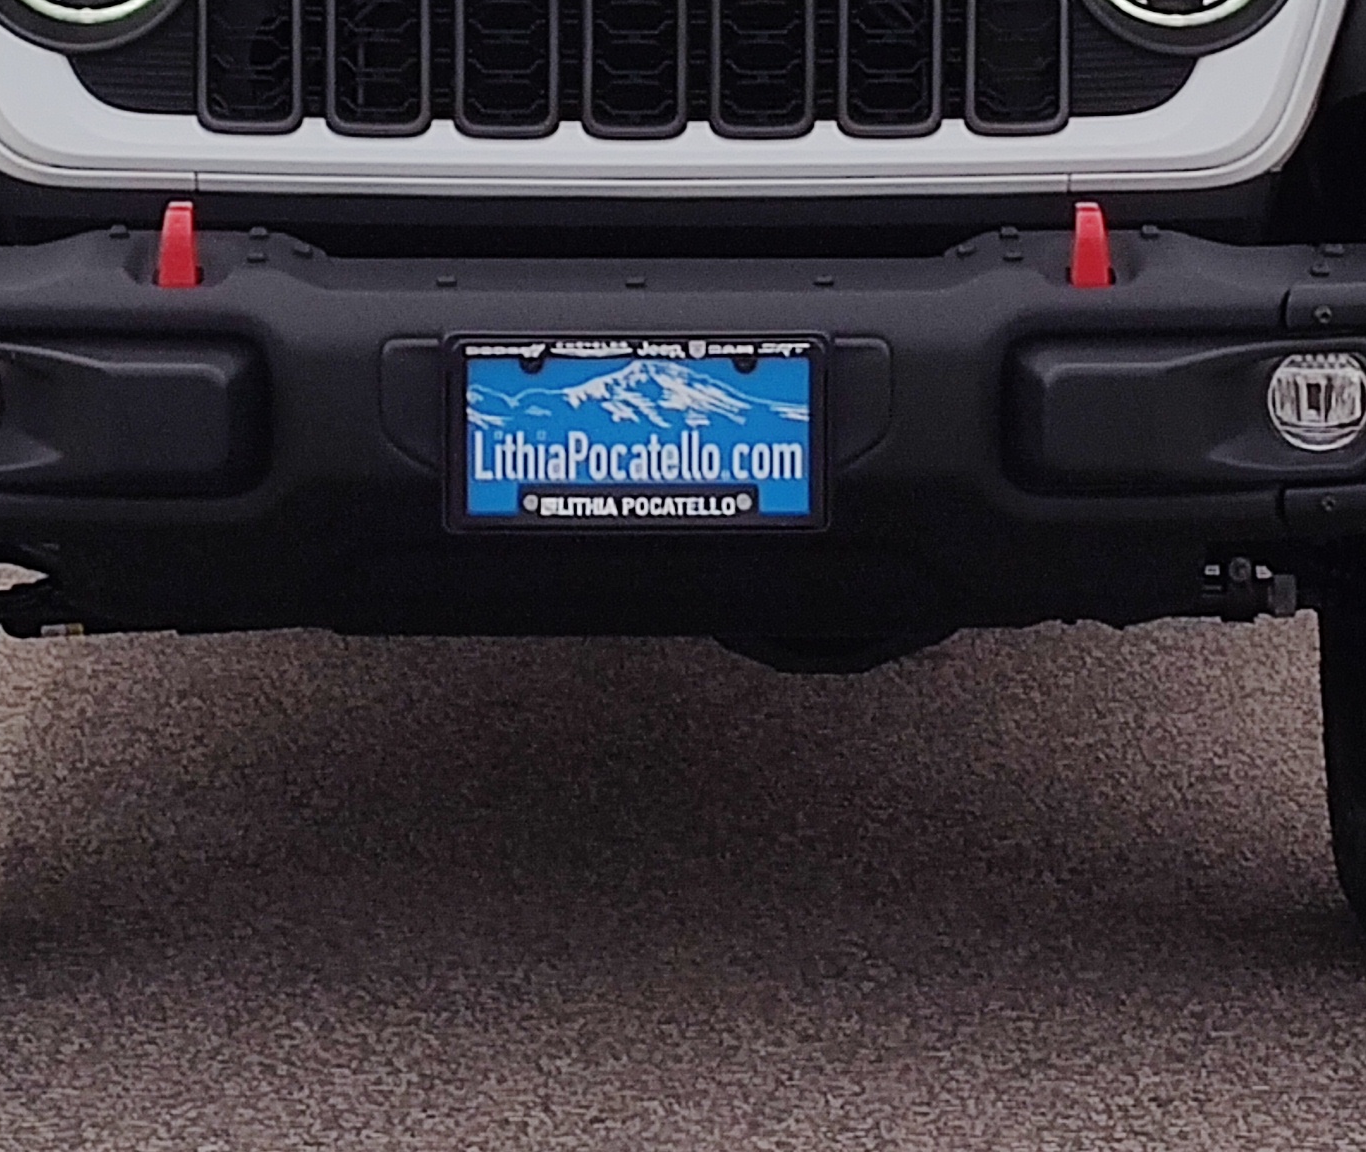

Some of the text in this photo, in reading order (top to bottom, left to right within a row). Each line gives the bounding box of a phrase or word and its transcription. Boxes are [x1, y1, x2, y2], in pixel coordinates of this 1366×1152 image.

[474, 429, 804, 481] LithiaPocatello.com
[558, 495, 737, 517] LITHIA POCATELLO
